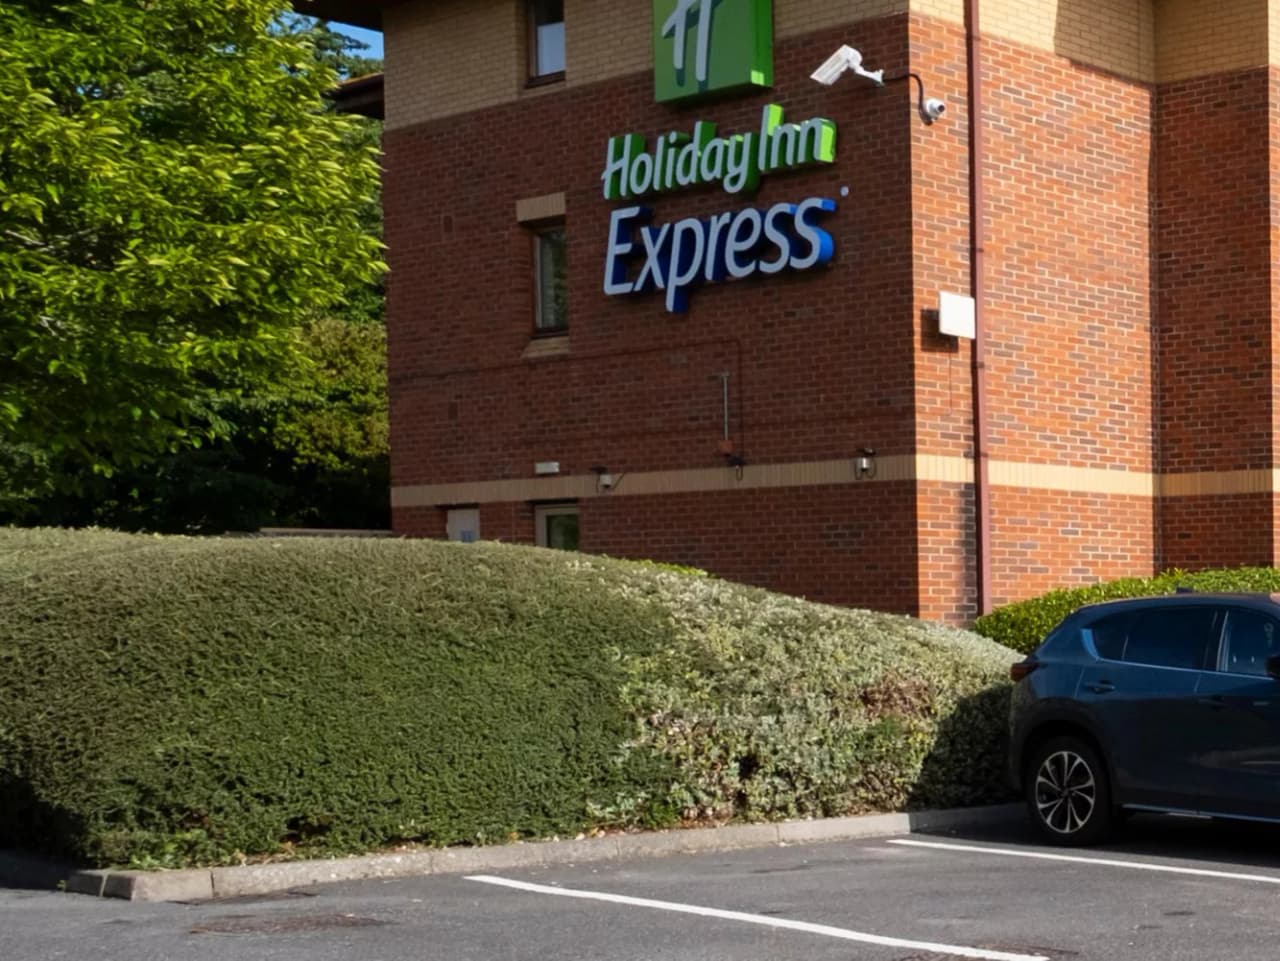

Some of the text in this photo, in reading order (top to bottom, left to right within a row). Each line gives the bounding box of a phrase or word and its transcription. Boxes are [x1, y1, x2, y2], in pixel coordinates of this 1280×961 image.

[601, 104, 834, 199] Holiday Inn
[603, 197, 837, 312] Express
